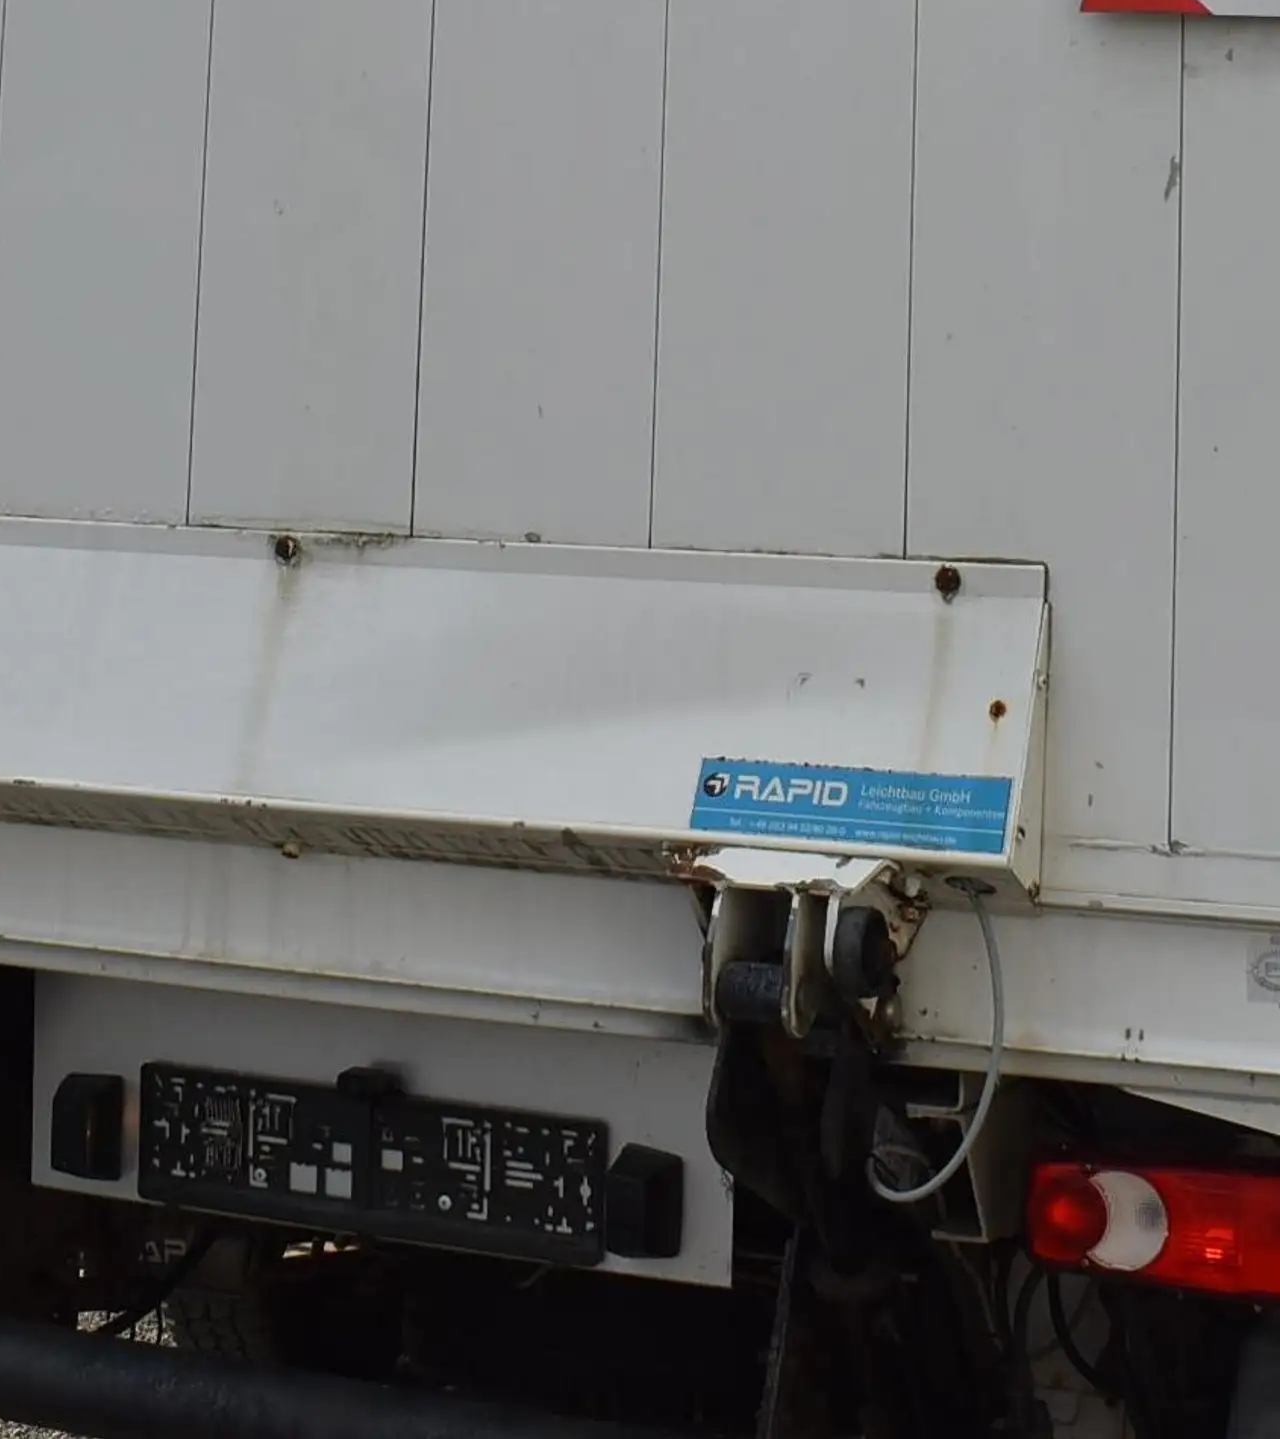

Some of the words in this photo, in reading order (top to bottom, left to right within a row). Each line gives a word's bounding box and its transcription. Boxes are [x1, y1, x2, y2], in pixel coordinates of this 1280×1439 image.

[733, 775, 848, 806] RAPID
[860, 783, 925, 802] Leichtbau
[929, 787, 972, 804] GmbH
